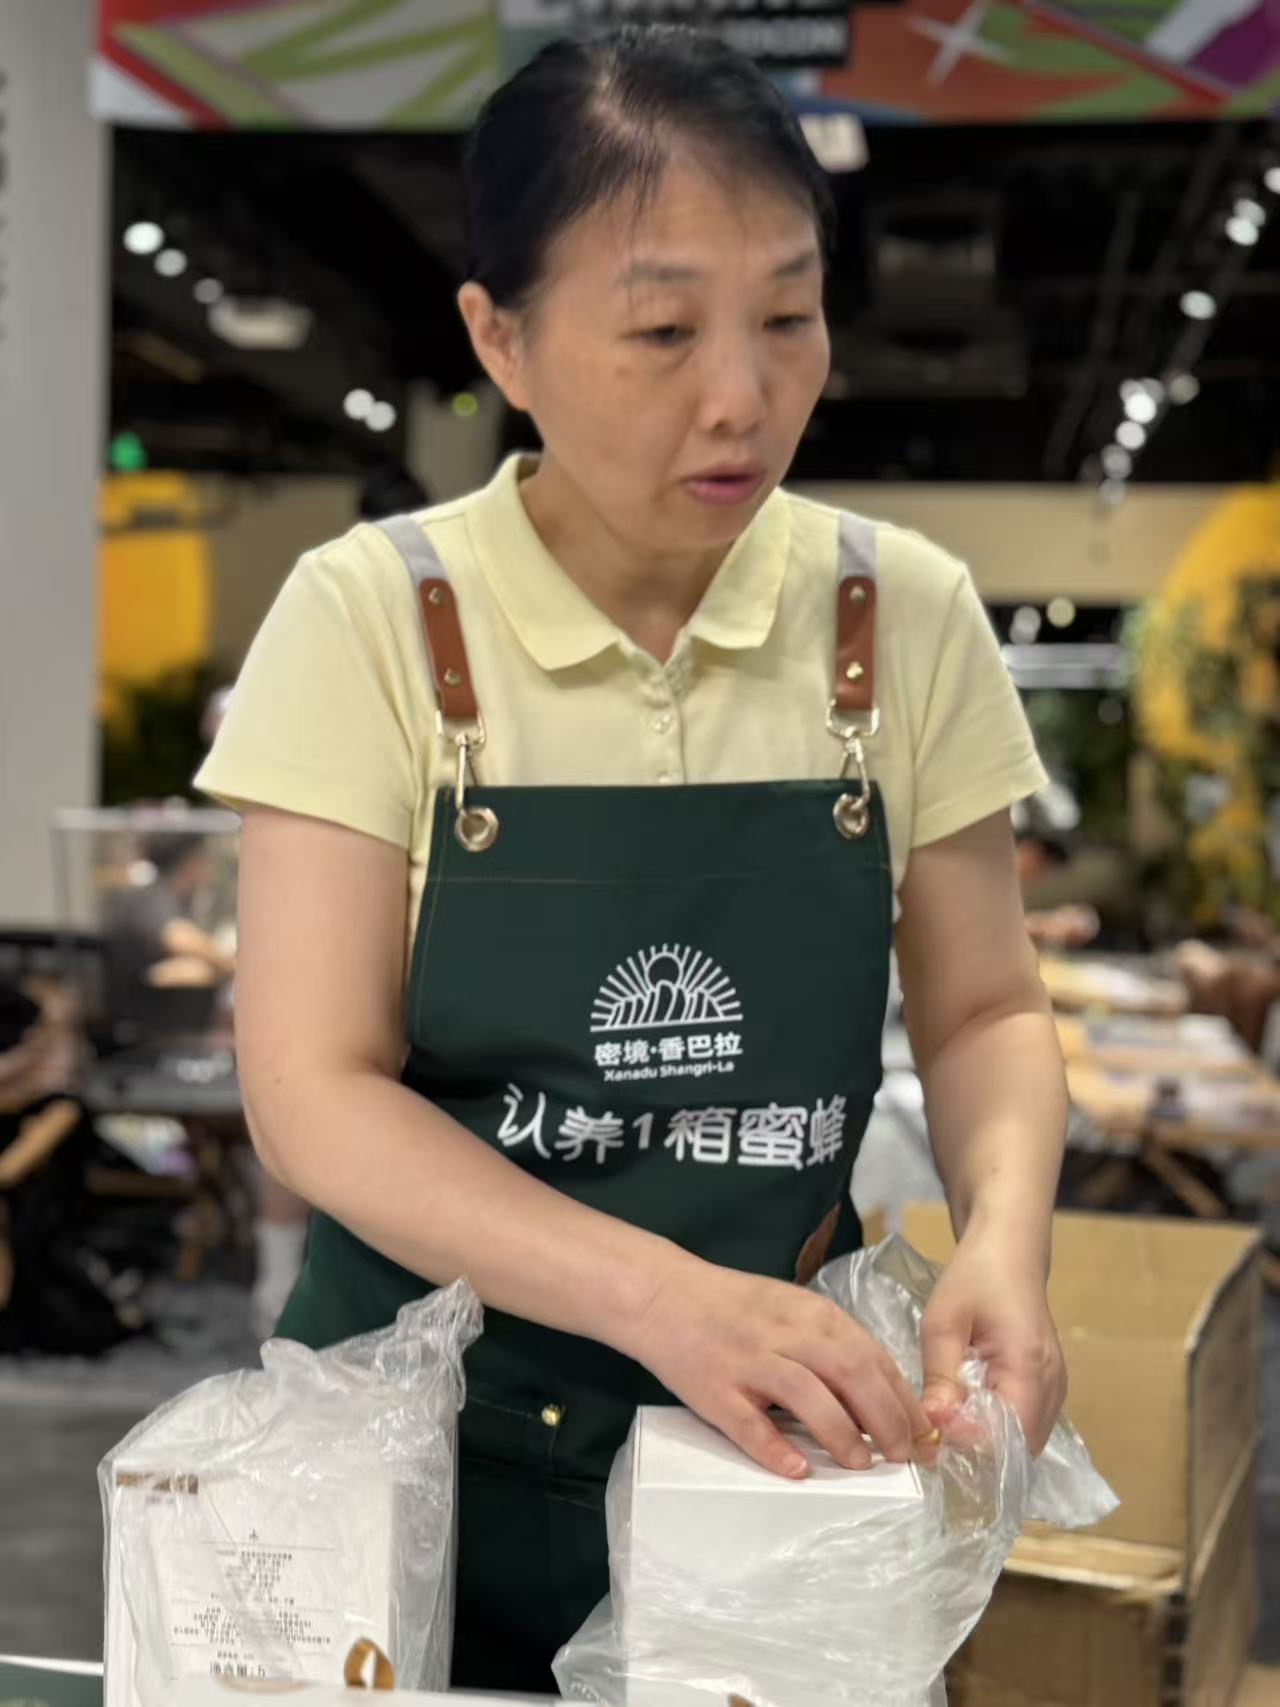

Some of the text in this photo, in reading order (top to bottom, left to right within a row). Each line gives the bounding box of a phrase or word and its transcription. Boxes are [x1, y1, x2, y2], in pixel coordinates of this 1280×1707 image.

[594, 1031, 743, 1067] 密境·香巴拉
[603, 1060, 736, 1082] Xanadu Shangri-La
[497, 1083, 847, 1171] 认养1箱蜜蜂
